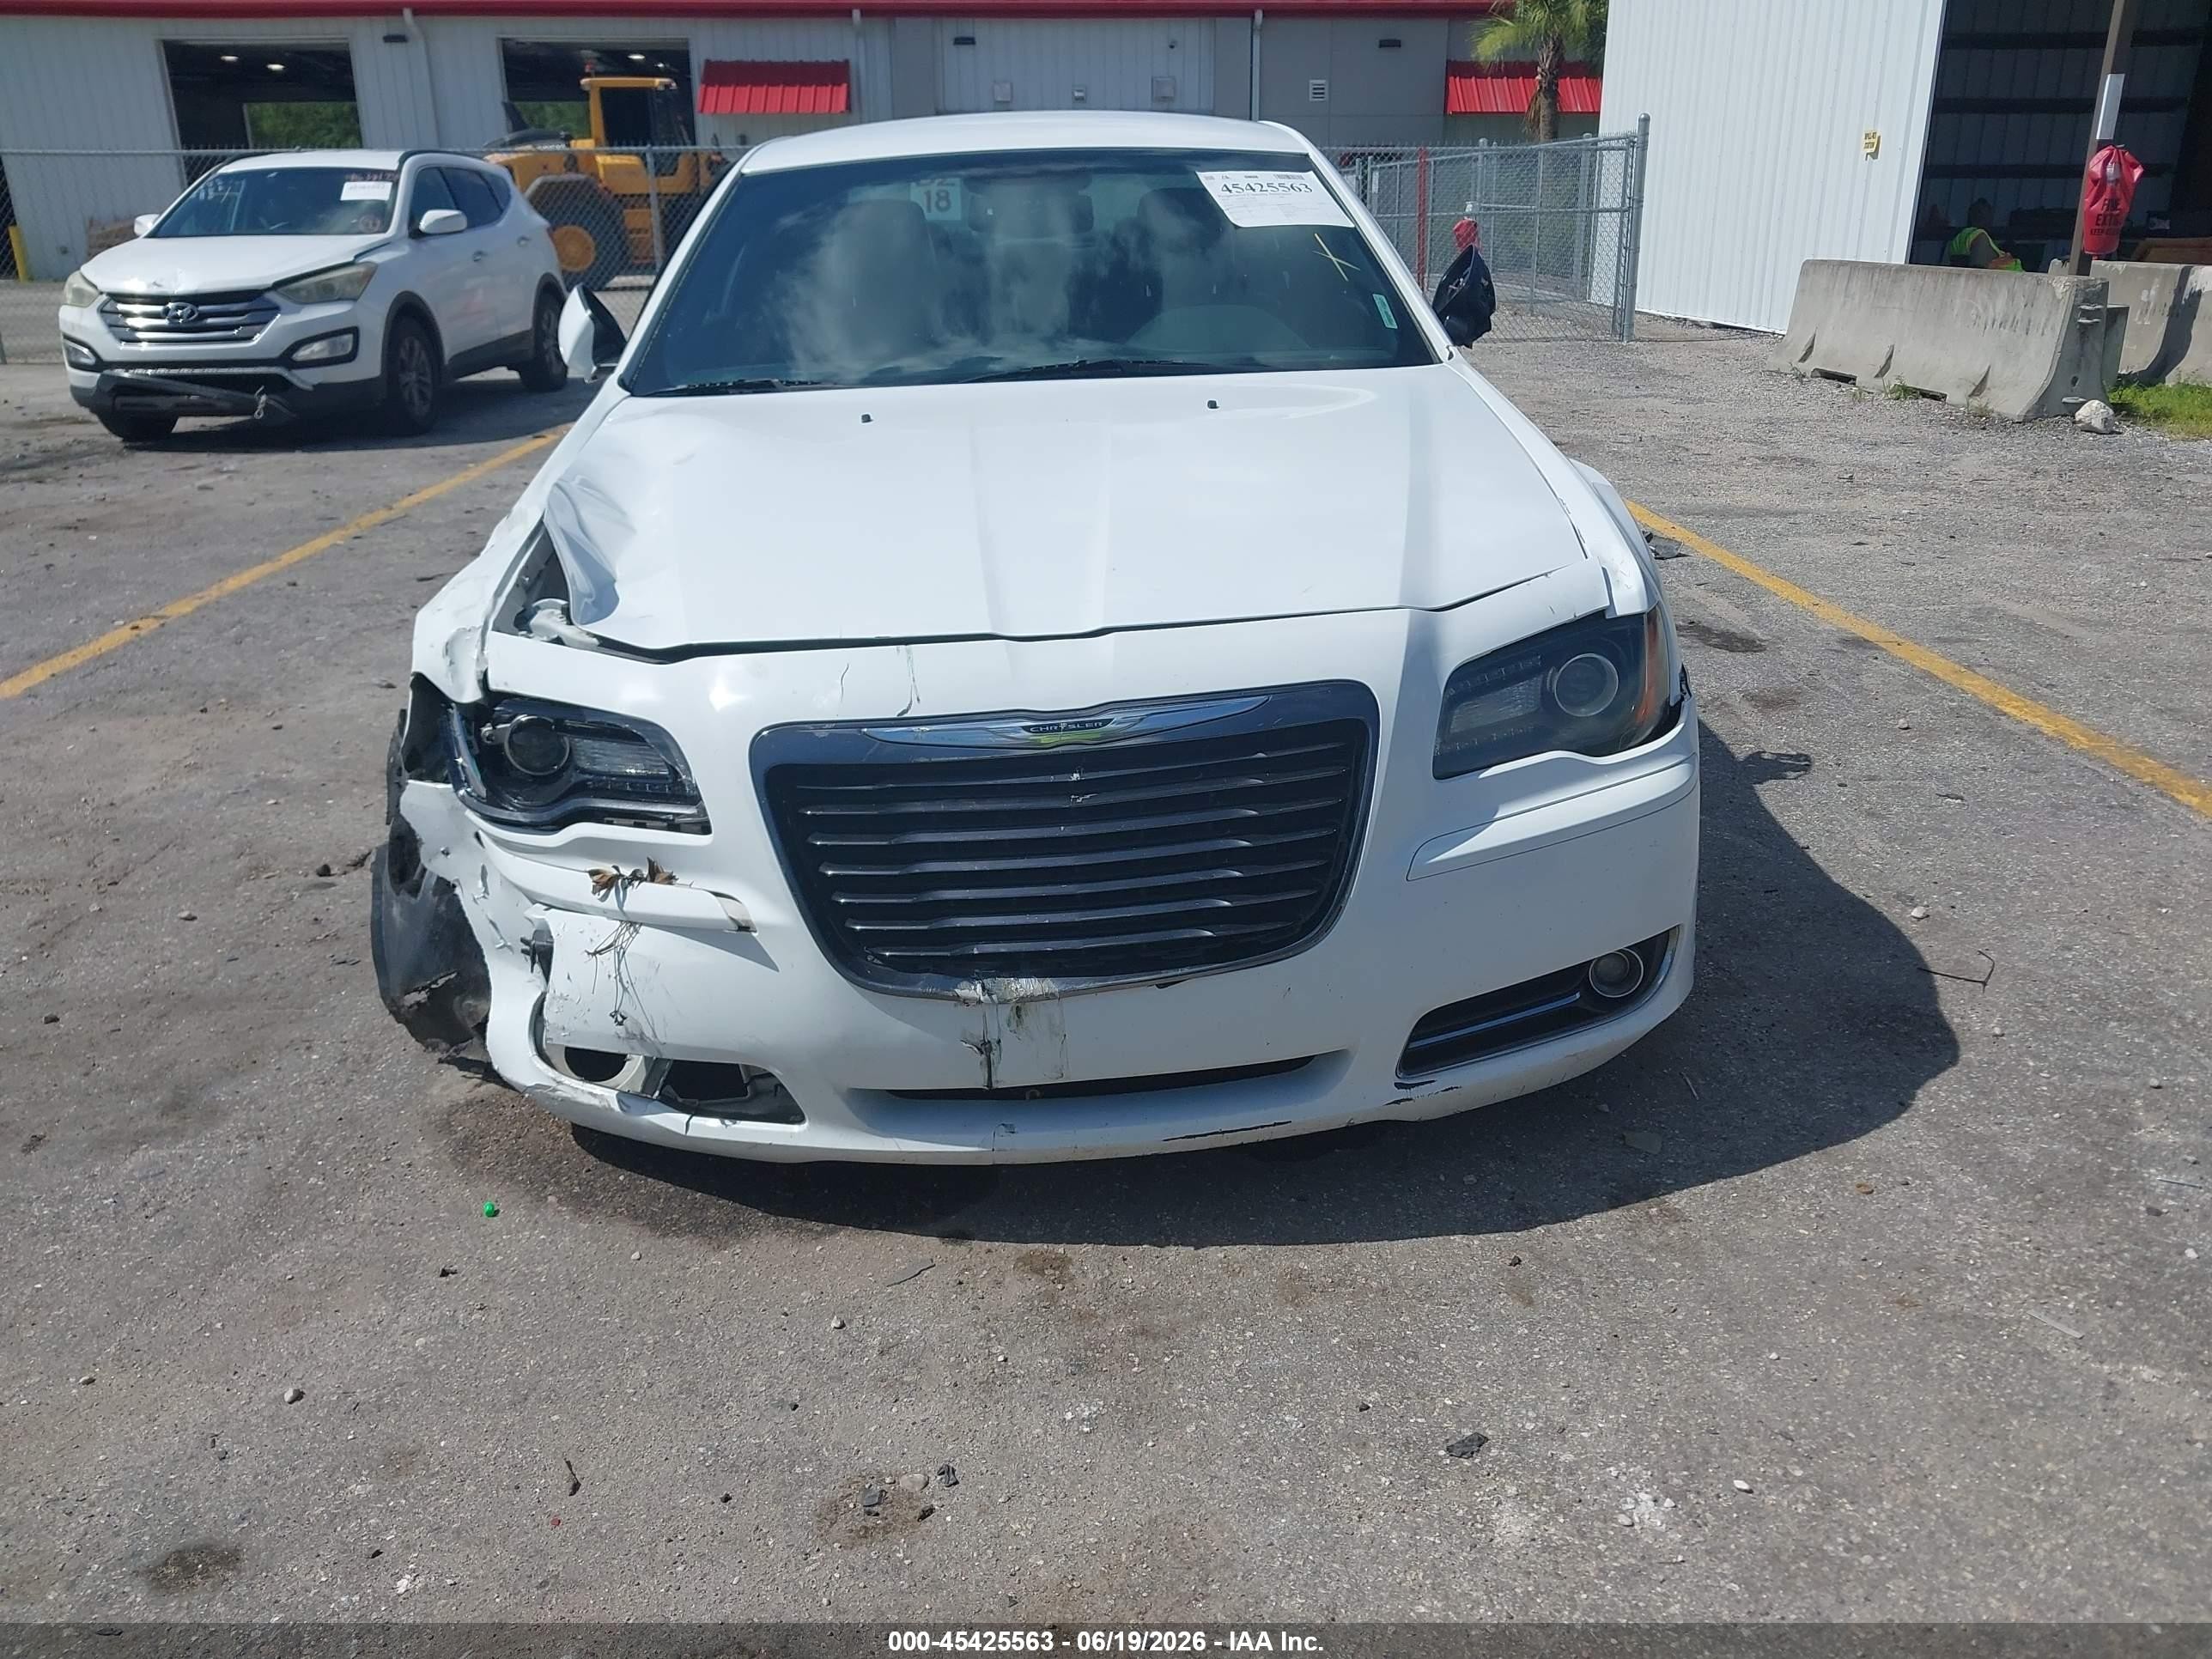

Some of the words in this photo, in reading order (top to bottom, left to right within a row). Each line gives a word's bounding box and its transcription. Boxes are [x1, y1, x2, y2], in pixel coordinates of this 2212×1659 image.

[1221, 183, 1313, 193] 45425563
[924, 190, 951, 213] 18
[1030, 722, 1103, 732] CHRYSLER
